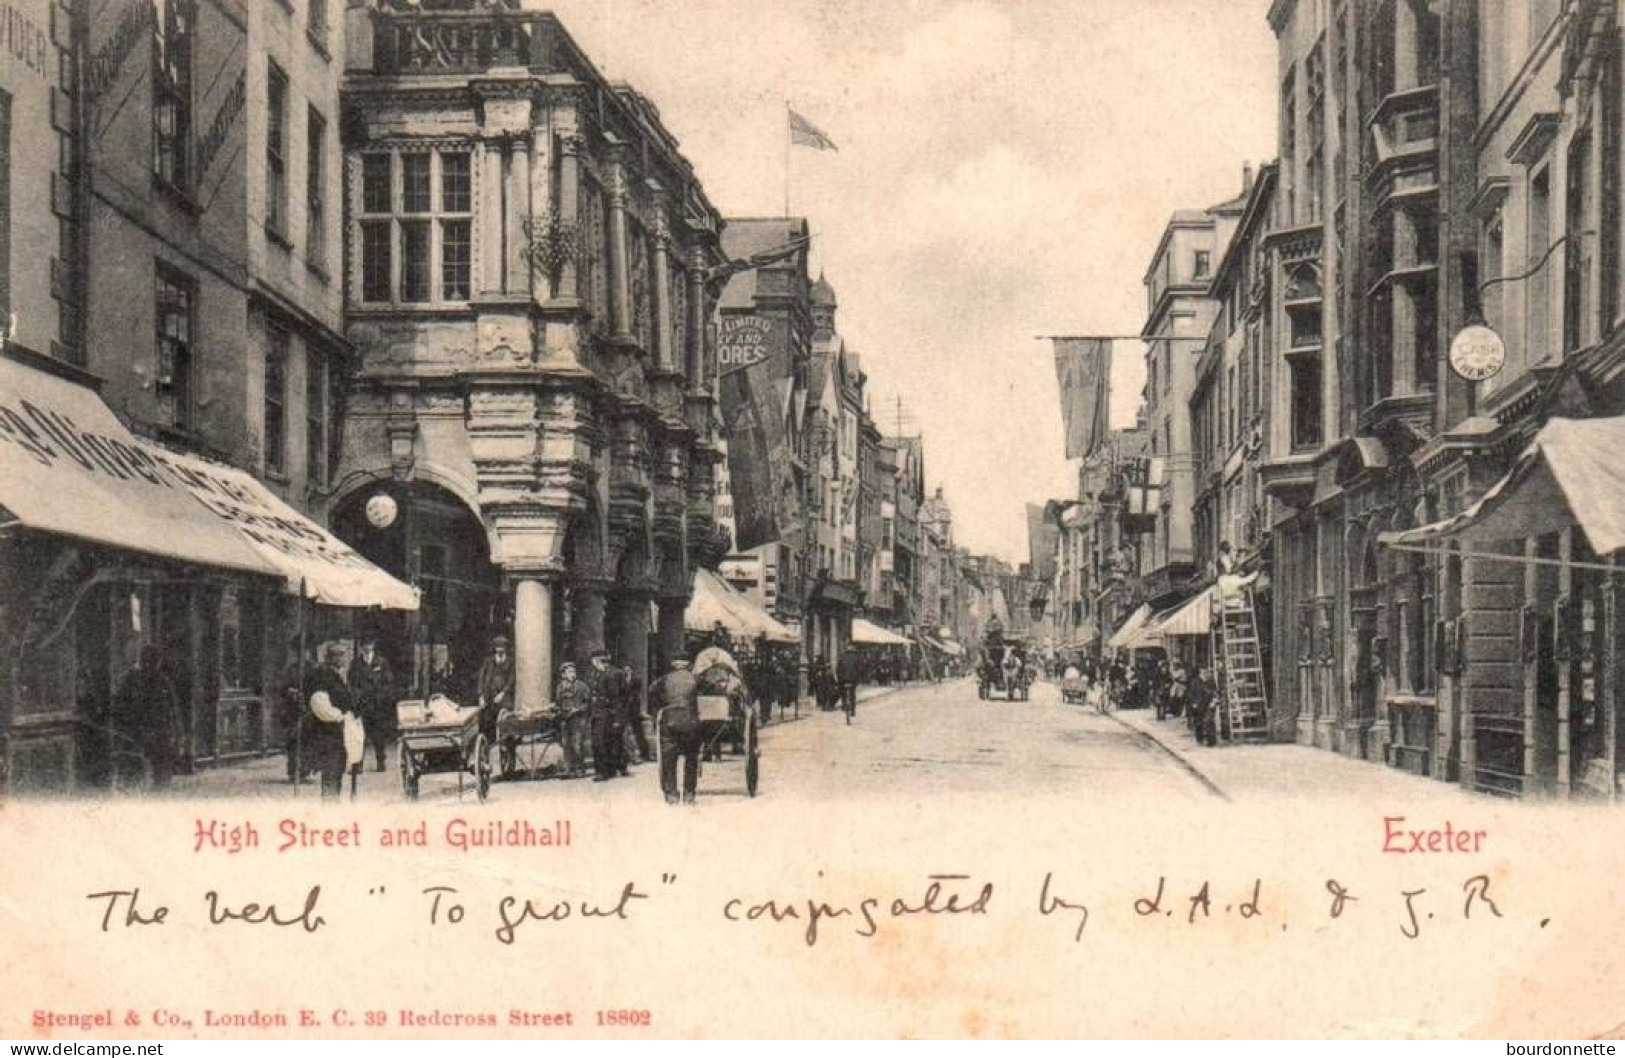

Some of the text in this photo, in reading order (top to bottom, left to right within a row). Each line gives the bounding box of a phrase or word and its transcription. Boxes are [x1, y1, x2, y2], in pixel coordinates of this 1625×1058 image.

[194, 819, 573, 854] High Street and Guildhall
[1382, 816, 1488, 855] Exeter
[87, 888, 169, 932] The
[206, 885, 325, 932] verb
[722, 871, 993, 946] conjugated
[1038, 872, 1089, 942] by
[31, 1010, 112, 1032] Stengel
[125, 1010, 141, 1027] &
[205, 1010, 287, 1028] London
[300, 1010, 322, 1027] E.
[333, 1010, 355, 1027] C.
[364, 1010, 388, 1028] 39
[399, 1010, 497, 1027] Redcross
[509, 1010, 573, 1027] Street
[595, 1010, 651, 1027] 18802
